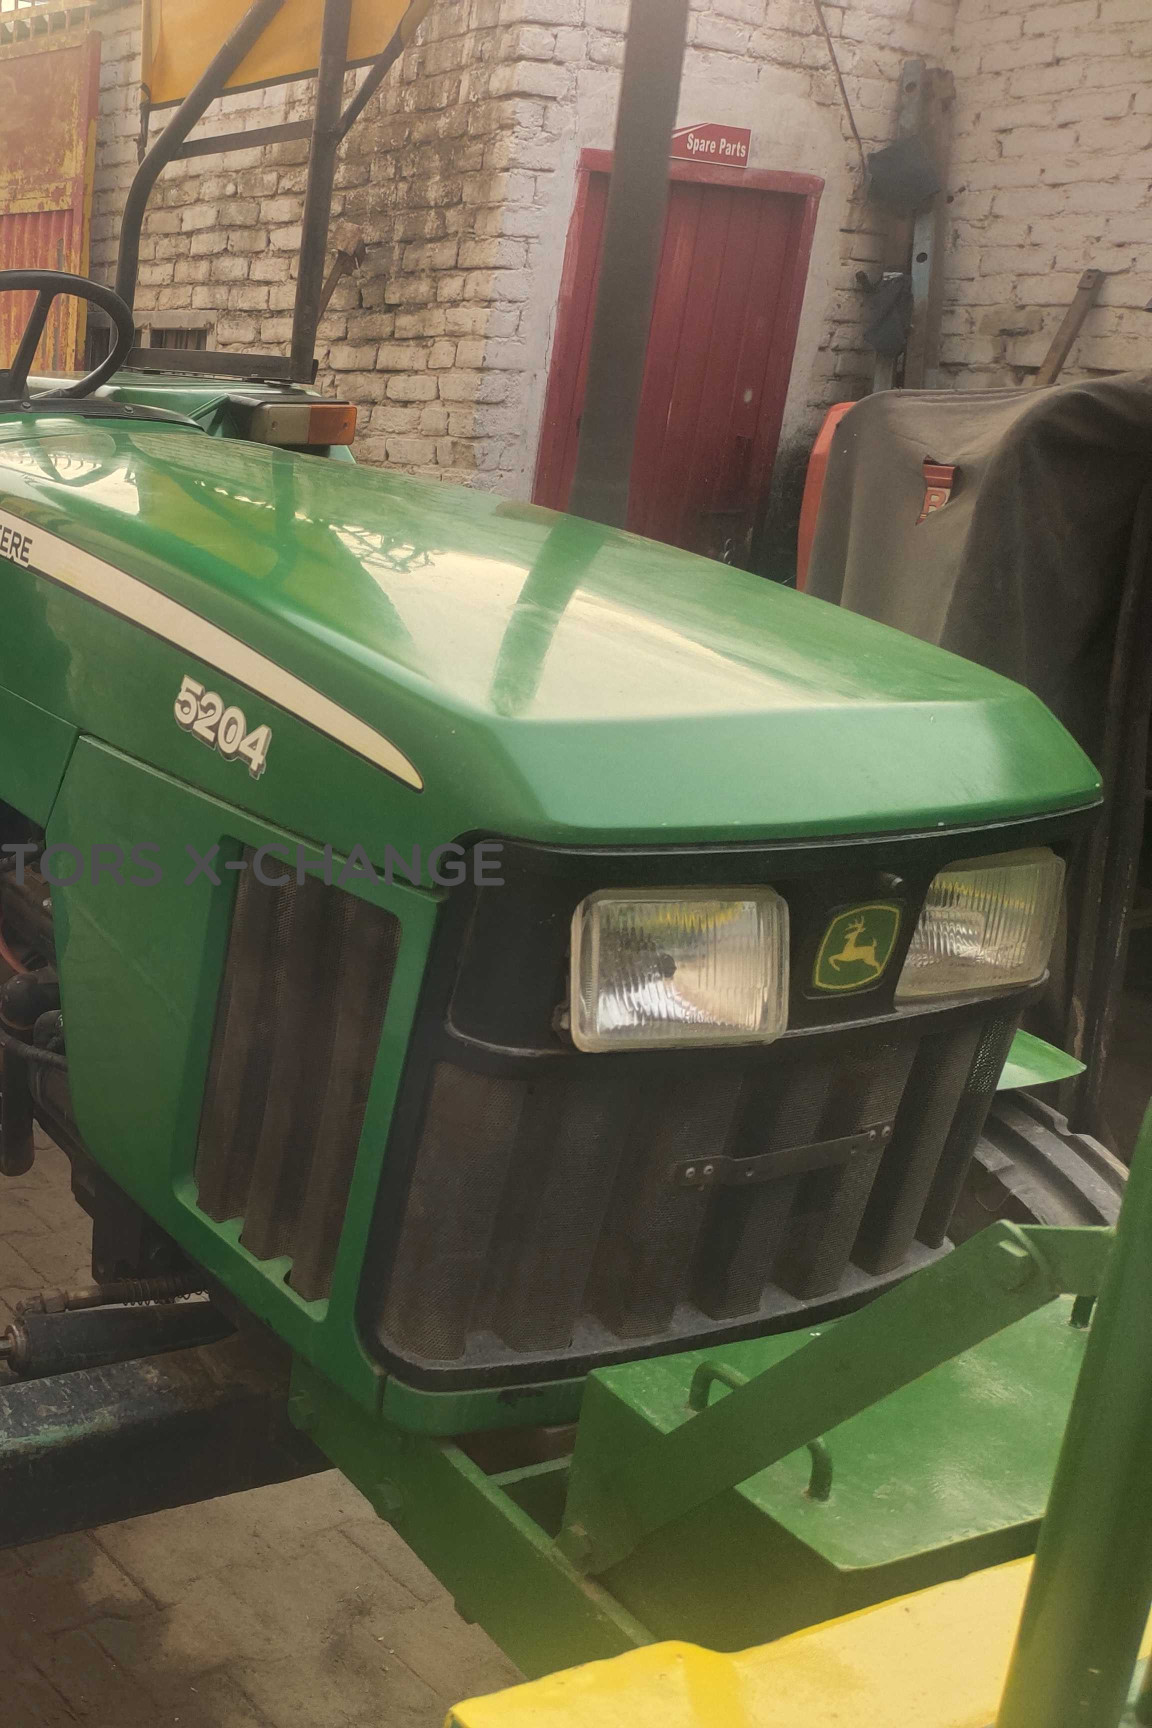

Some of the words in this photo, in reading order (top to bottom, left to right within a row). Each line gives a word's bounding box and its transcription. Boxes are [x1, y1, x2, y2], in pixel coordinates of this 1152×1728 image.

[687, 133, 716, 154] Spare
[719, 138, 746, 158] Parts
[174, 674, 272, 780] 5204
